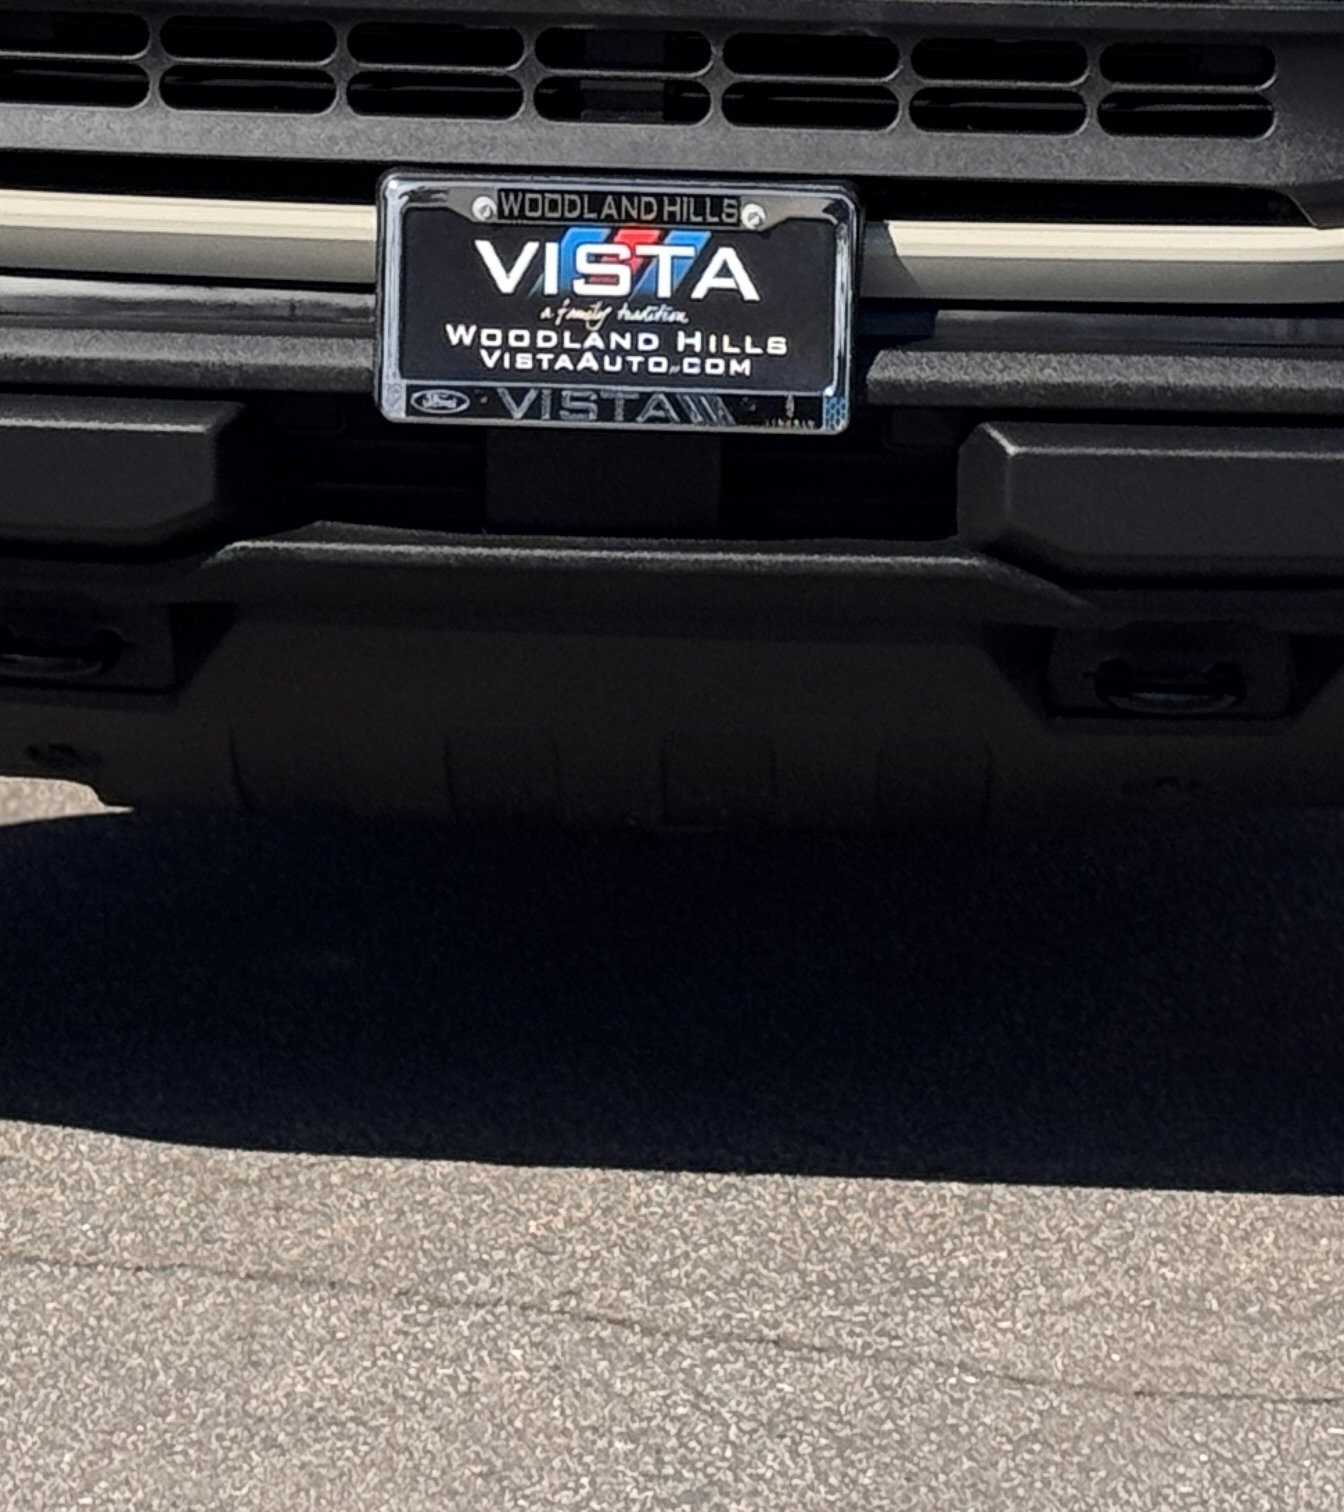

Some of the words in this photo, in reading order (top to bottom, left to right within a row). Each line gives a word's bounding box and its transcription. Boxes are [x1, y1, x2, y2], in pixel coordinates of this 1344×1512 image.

[499, 191, 658, 222] WOODLAND
[662, 196, 739, 224] HILLS
[474, 239, 761, 302] VISTA
[445, 324, 660, 352] WOODLAND
[676, 330, 789, 356] HILLS
[496, 387, 681, 424] VISTA
